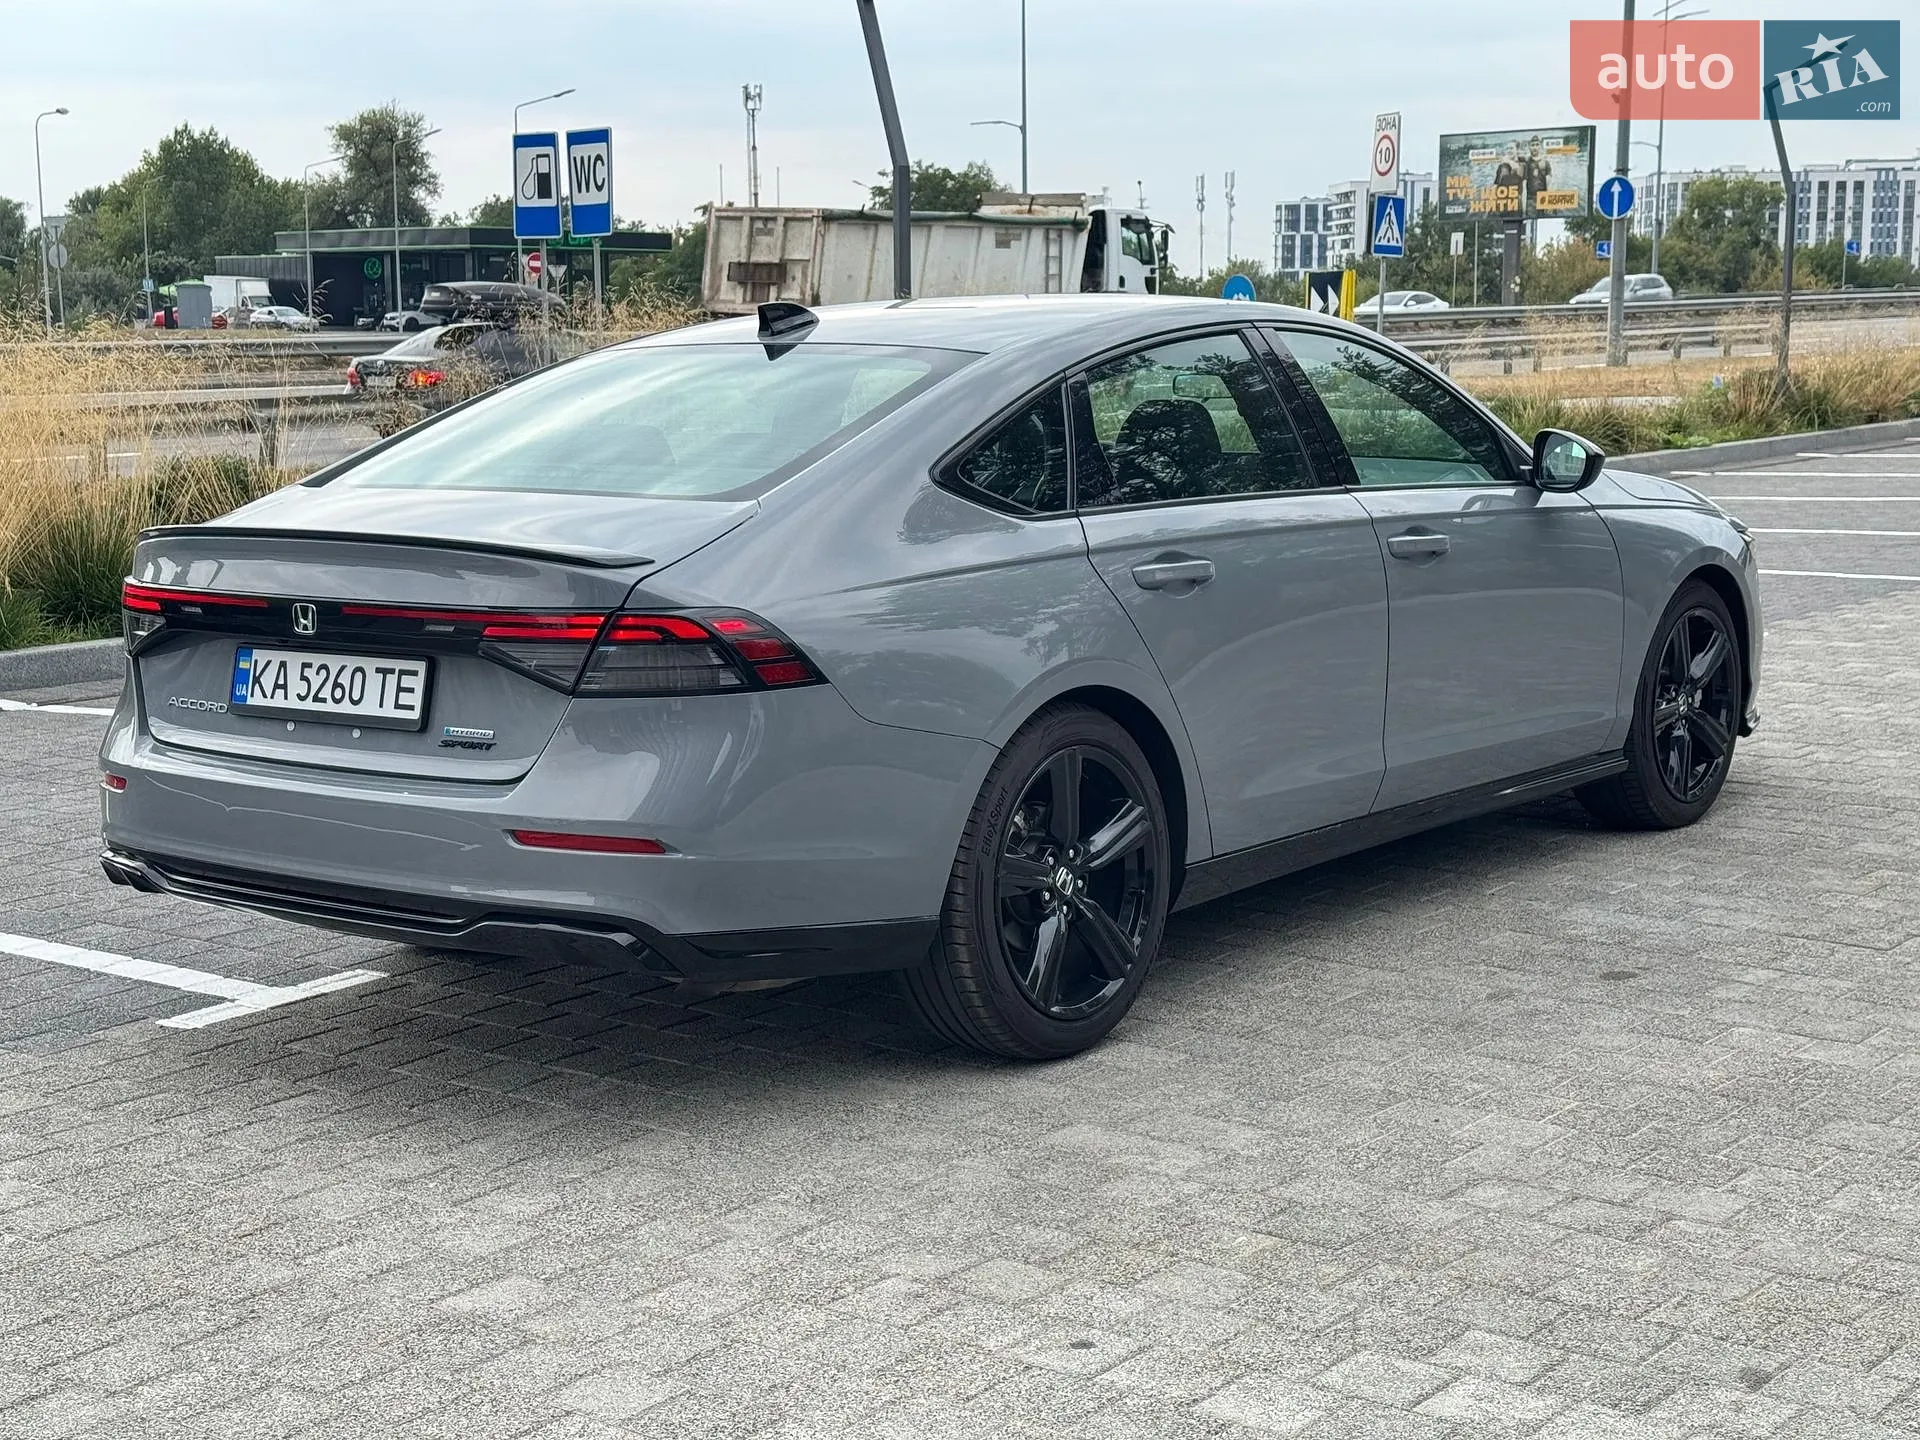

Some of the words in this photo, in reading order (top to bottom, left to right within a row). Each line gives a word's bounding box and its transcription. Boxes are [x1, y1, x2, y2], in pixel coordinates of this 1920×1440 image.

[1376, 116, 1397, 132] ЗОНА
[1378, 146, 1391, 165] 10
[573, 153, 606, 194] WC
[1469, 199, 1519, 213] ЖИТИ
[235, 683, 247, 697] UA
[250, 659, 289, 701] KA
[296, 662, 367, 706] 5260
[375, 666, 419, 712] TE
[168, 696, 229, 713] ACCORD
[438, 740, 497, 751] SPORT
